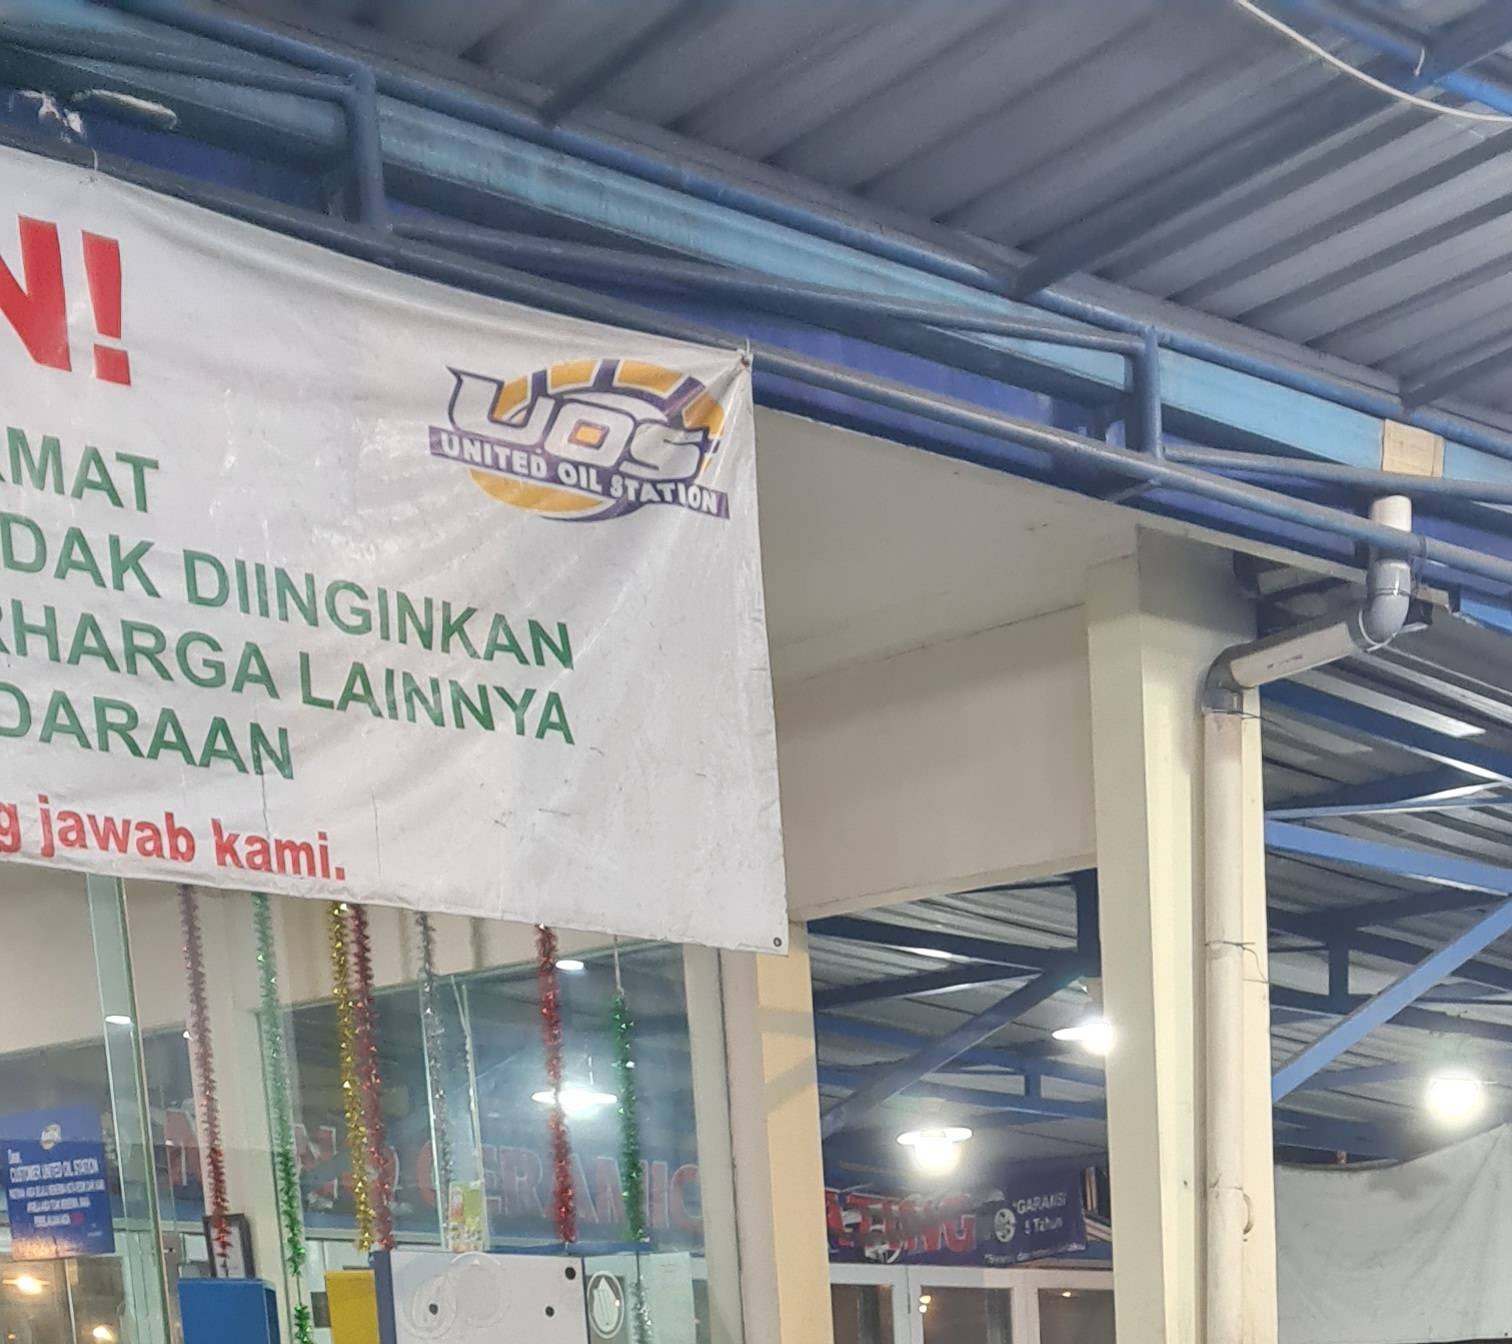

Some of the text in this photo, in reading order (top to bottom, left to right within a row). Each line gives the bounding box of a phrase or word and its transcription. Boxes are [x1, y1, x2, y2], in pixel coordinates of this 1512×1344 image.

[0, 426, 159, 513] MAT
[446, 367, 705, 481] UOS
[440, 432, 717, 514] UNITED OIL STATION
[0, 511, 575, 670] DAK DIINGINKAN
[0, 681, 295, 780] DARAAN
[300, 652, 575, 745] LAINNYA
[38, 794, 196, 863] jawab
[211, 817, 346, 881] kami.
